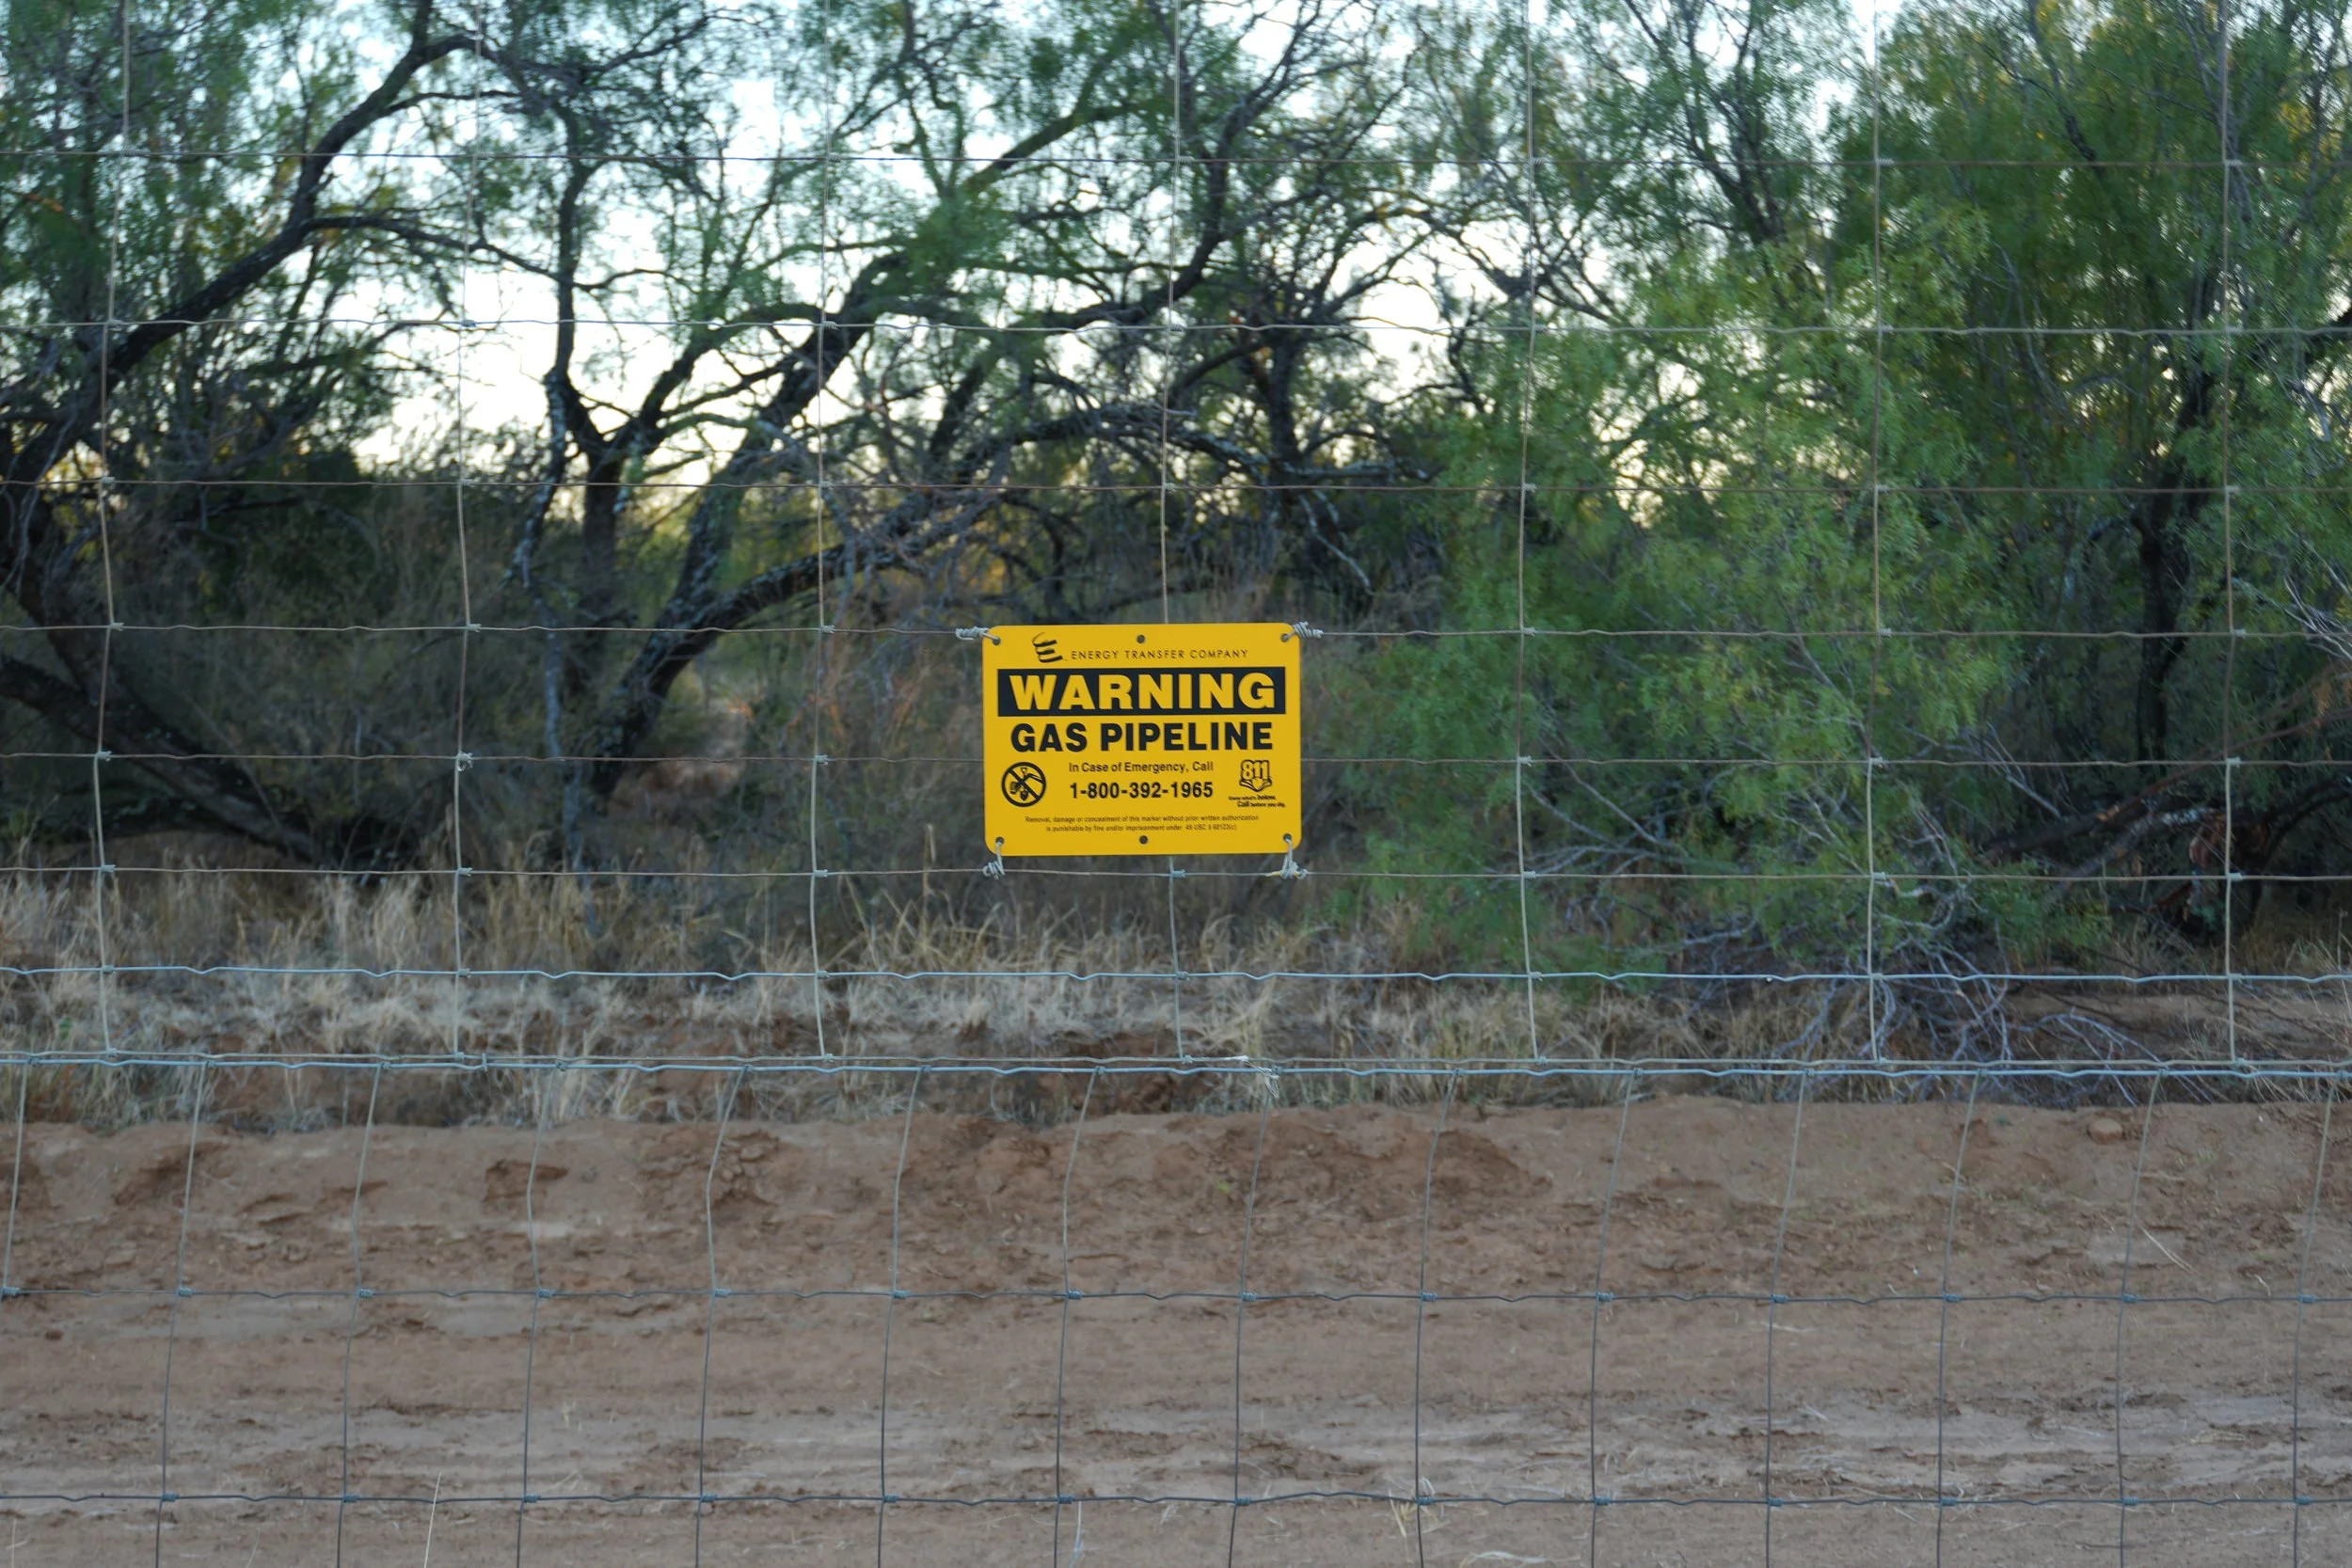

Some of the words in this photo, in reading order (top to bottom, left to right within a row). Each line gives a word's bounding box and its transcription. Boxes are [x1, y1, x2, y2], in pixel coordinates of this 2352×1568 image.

[1071, 650, 1119, 660] ENERGY
[1124, 649, 1184, 659] TRANSFER
[1189, 649, 1248, 659] COMPANY
[1009, 673, 1275, 710] WARNING
[1010, 722, 1089, 753] GAS
[1100, 721, 1273, 752] PIPELINE
[1069, 762, 1079, 772] In
[1081, 762, 1108, 772] Case
[1111, 762, 1121, 772] of
[1124, 761, 1189, 774] Emergency,
[1192, 761, 1214, 771] Call
[1240, 759, 1270, 780] 811
[1070, 781, 1214, 799] 1-800-392-1965
